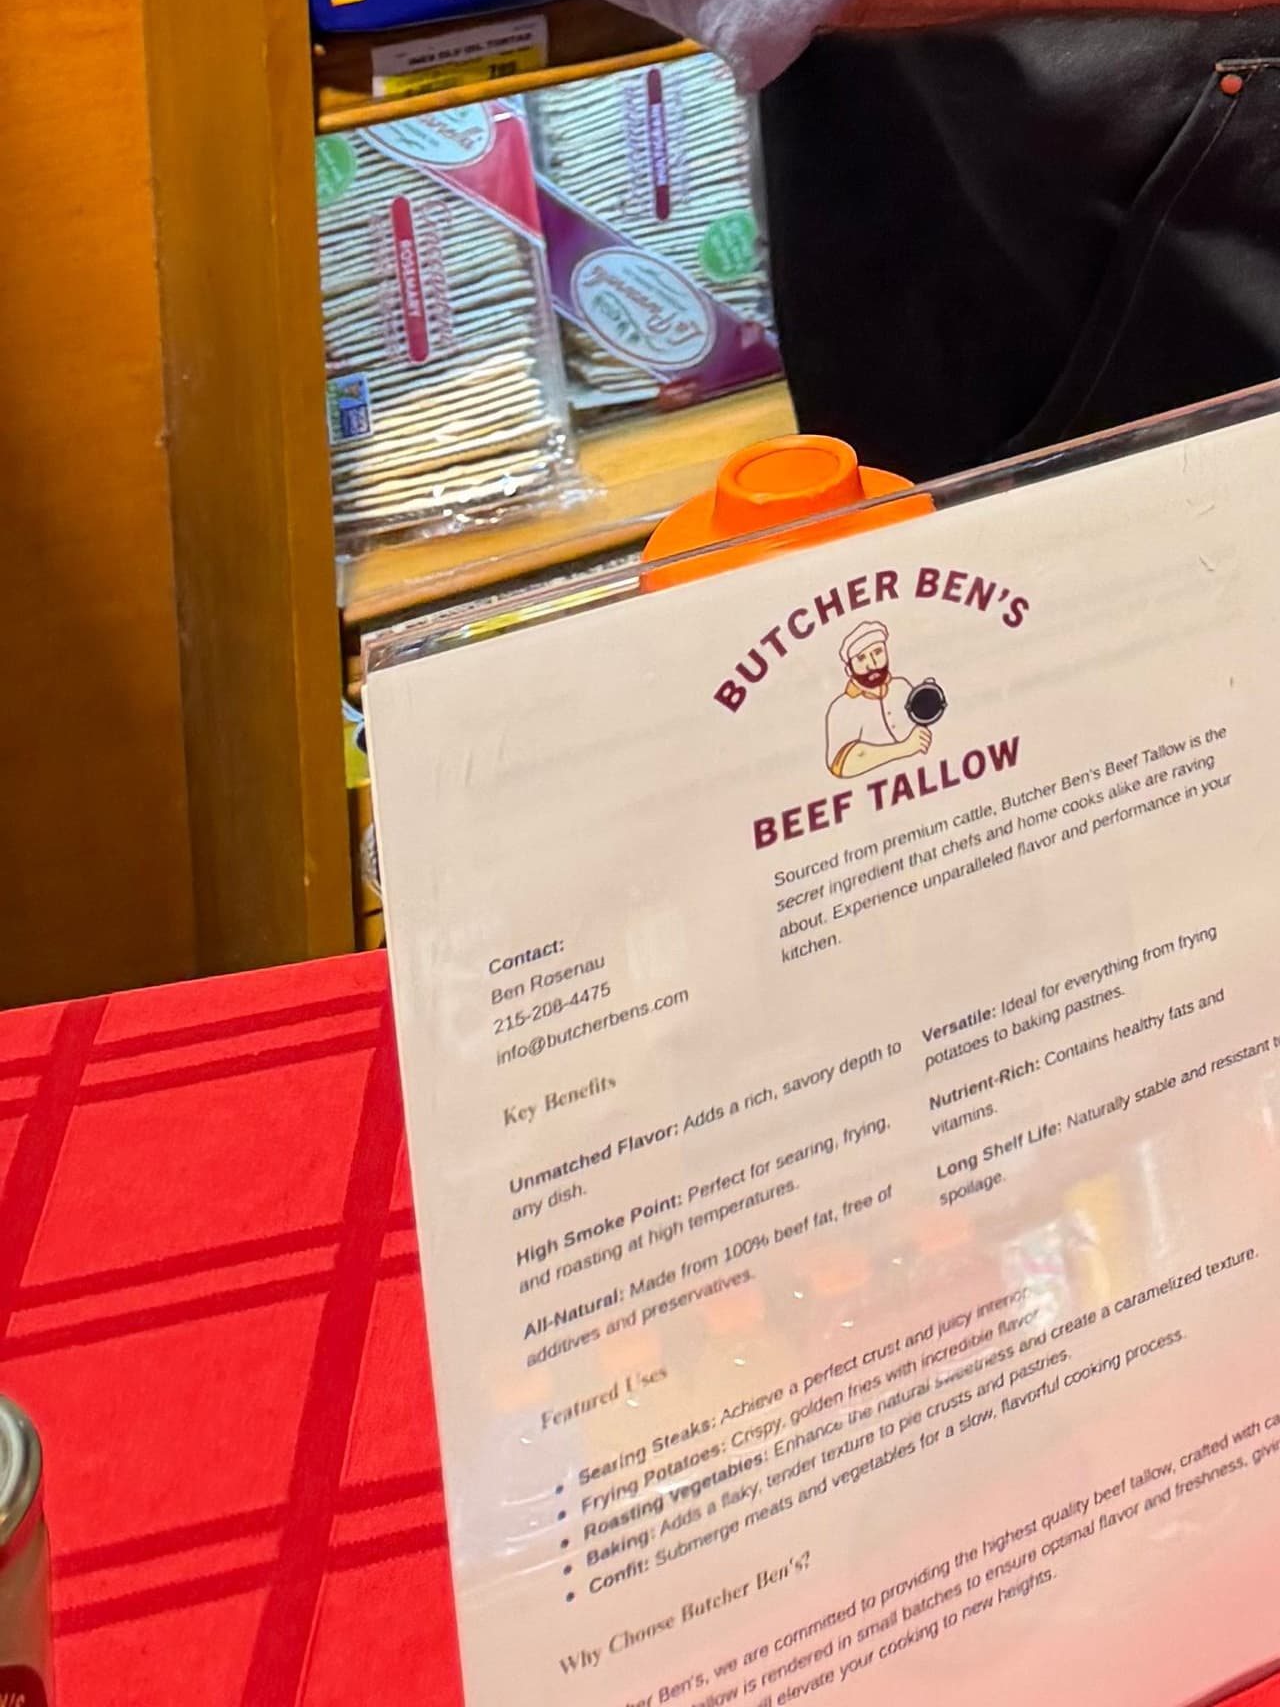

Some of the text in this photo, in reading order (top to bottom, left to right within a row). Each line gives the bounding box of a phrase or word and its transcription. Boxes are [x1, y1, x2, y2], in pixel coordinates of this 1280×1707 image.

[714, 567, 1031, 714] BUTCHER BEN'S
[752, 735, 1021, 850] BEEF TALLOW
[773, 852, 839, 888] Sourced
[843, 841, 878, 863] from
[882, 819, 949, 860] premium
[1001, 781, 1057, 812] Butcher
[1061, 766, 1101, 793] Ben's
[1105, 754, 1139, 774] Beef
[1140, 737, 1187, 767] Tallow
[1189, 736, 1201, 749] is
[1205, 725, 1227, 744] the
[488, 938, 565, 975] Contact:
[491, 955, 605, 1005] Ben Rosenau
[496, 989, 689, 1067] info@butcherbens.com
[922, 1006, 996, 1043] Versatile:
[503, 1076, 617, 1127] Key Benefits
[930, 1058, 1041, 1110] Nutrient-Rich:
[509, 1122, 678, 1194] Unmatched Flavor:
[516, 1196, 682, 1267] High Smoke Point:
[523, 1287, 625, 1340] All-Natural:
